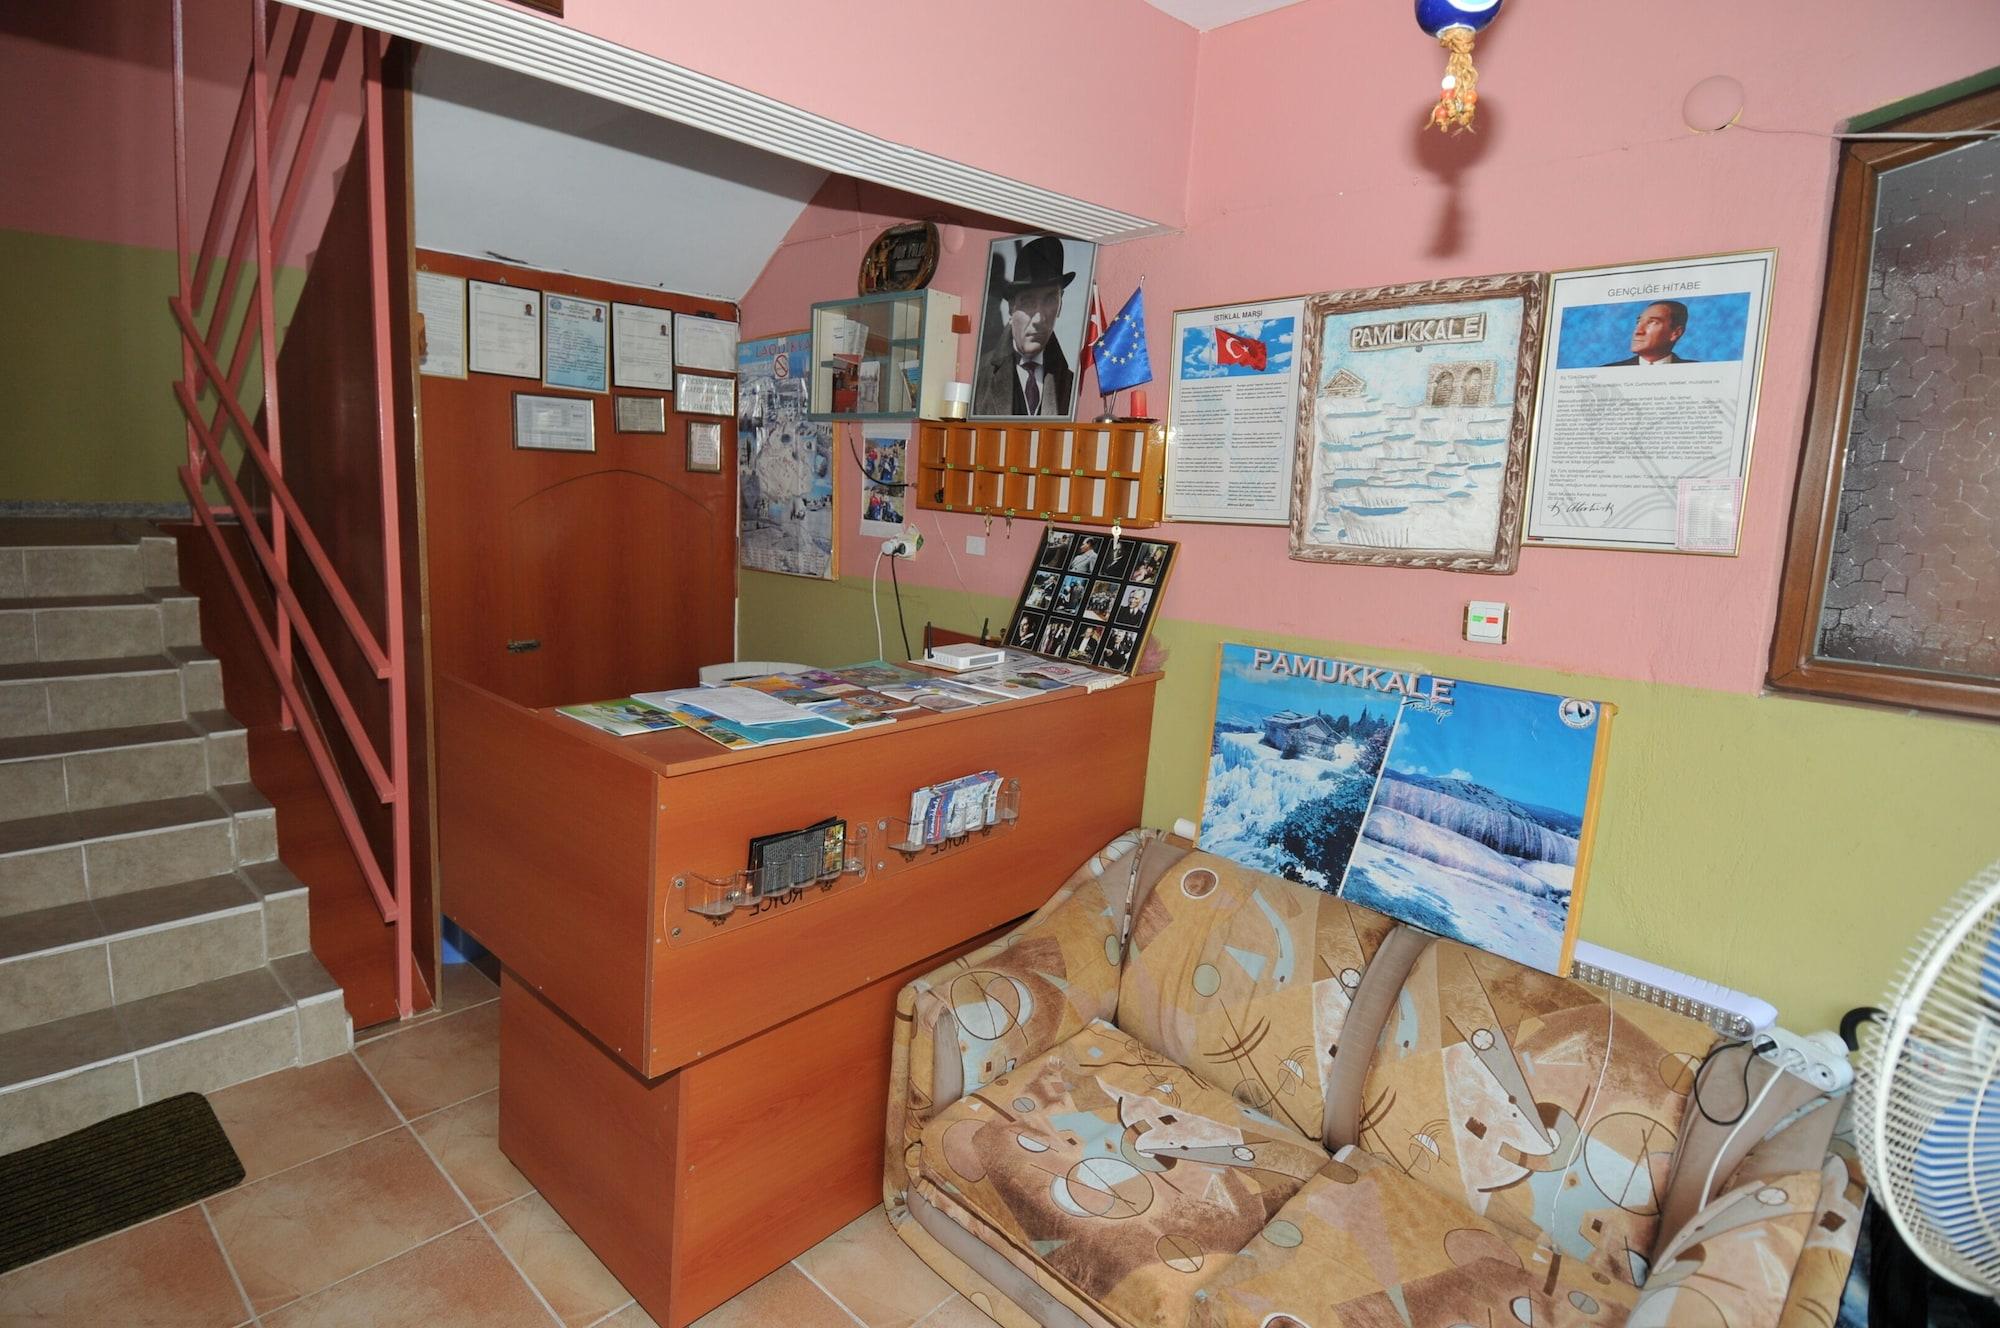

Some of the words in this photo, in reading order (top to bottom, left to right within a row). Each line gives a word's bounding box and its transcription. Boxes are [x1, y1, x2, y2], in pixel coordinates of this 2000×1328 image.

[1607, 282, 1661, 297] GENÇLİĞE
[1662, 280, 1701, 292] HİTABE
[1351, 316, 1481, 347] PAMUKKALE
[1254, 648, 1457, 706] PAMUKKALE
